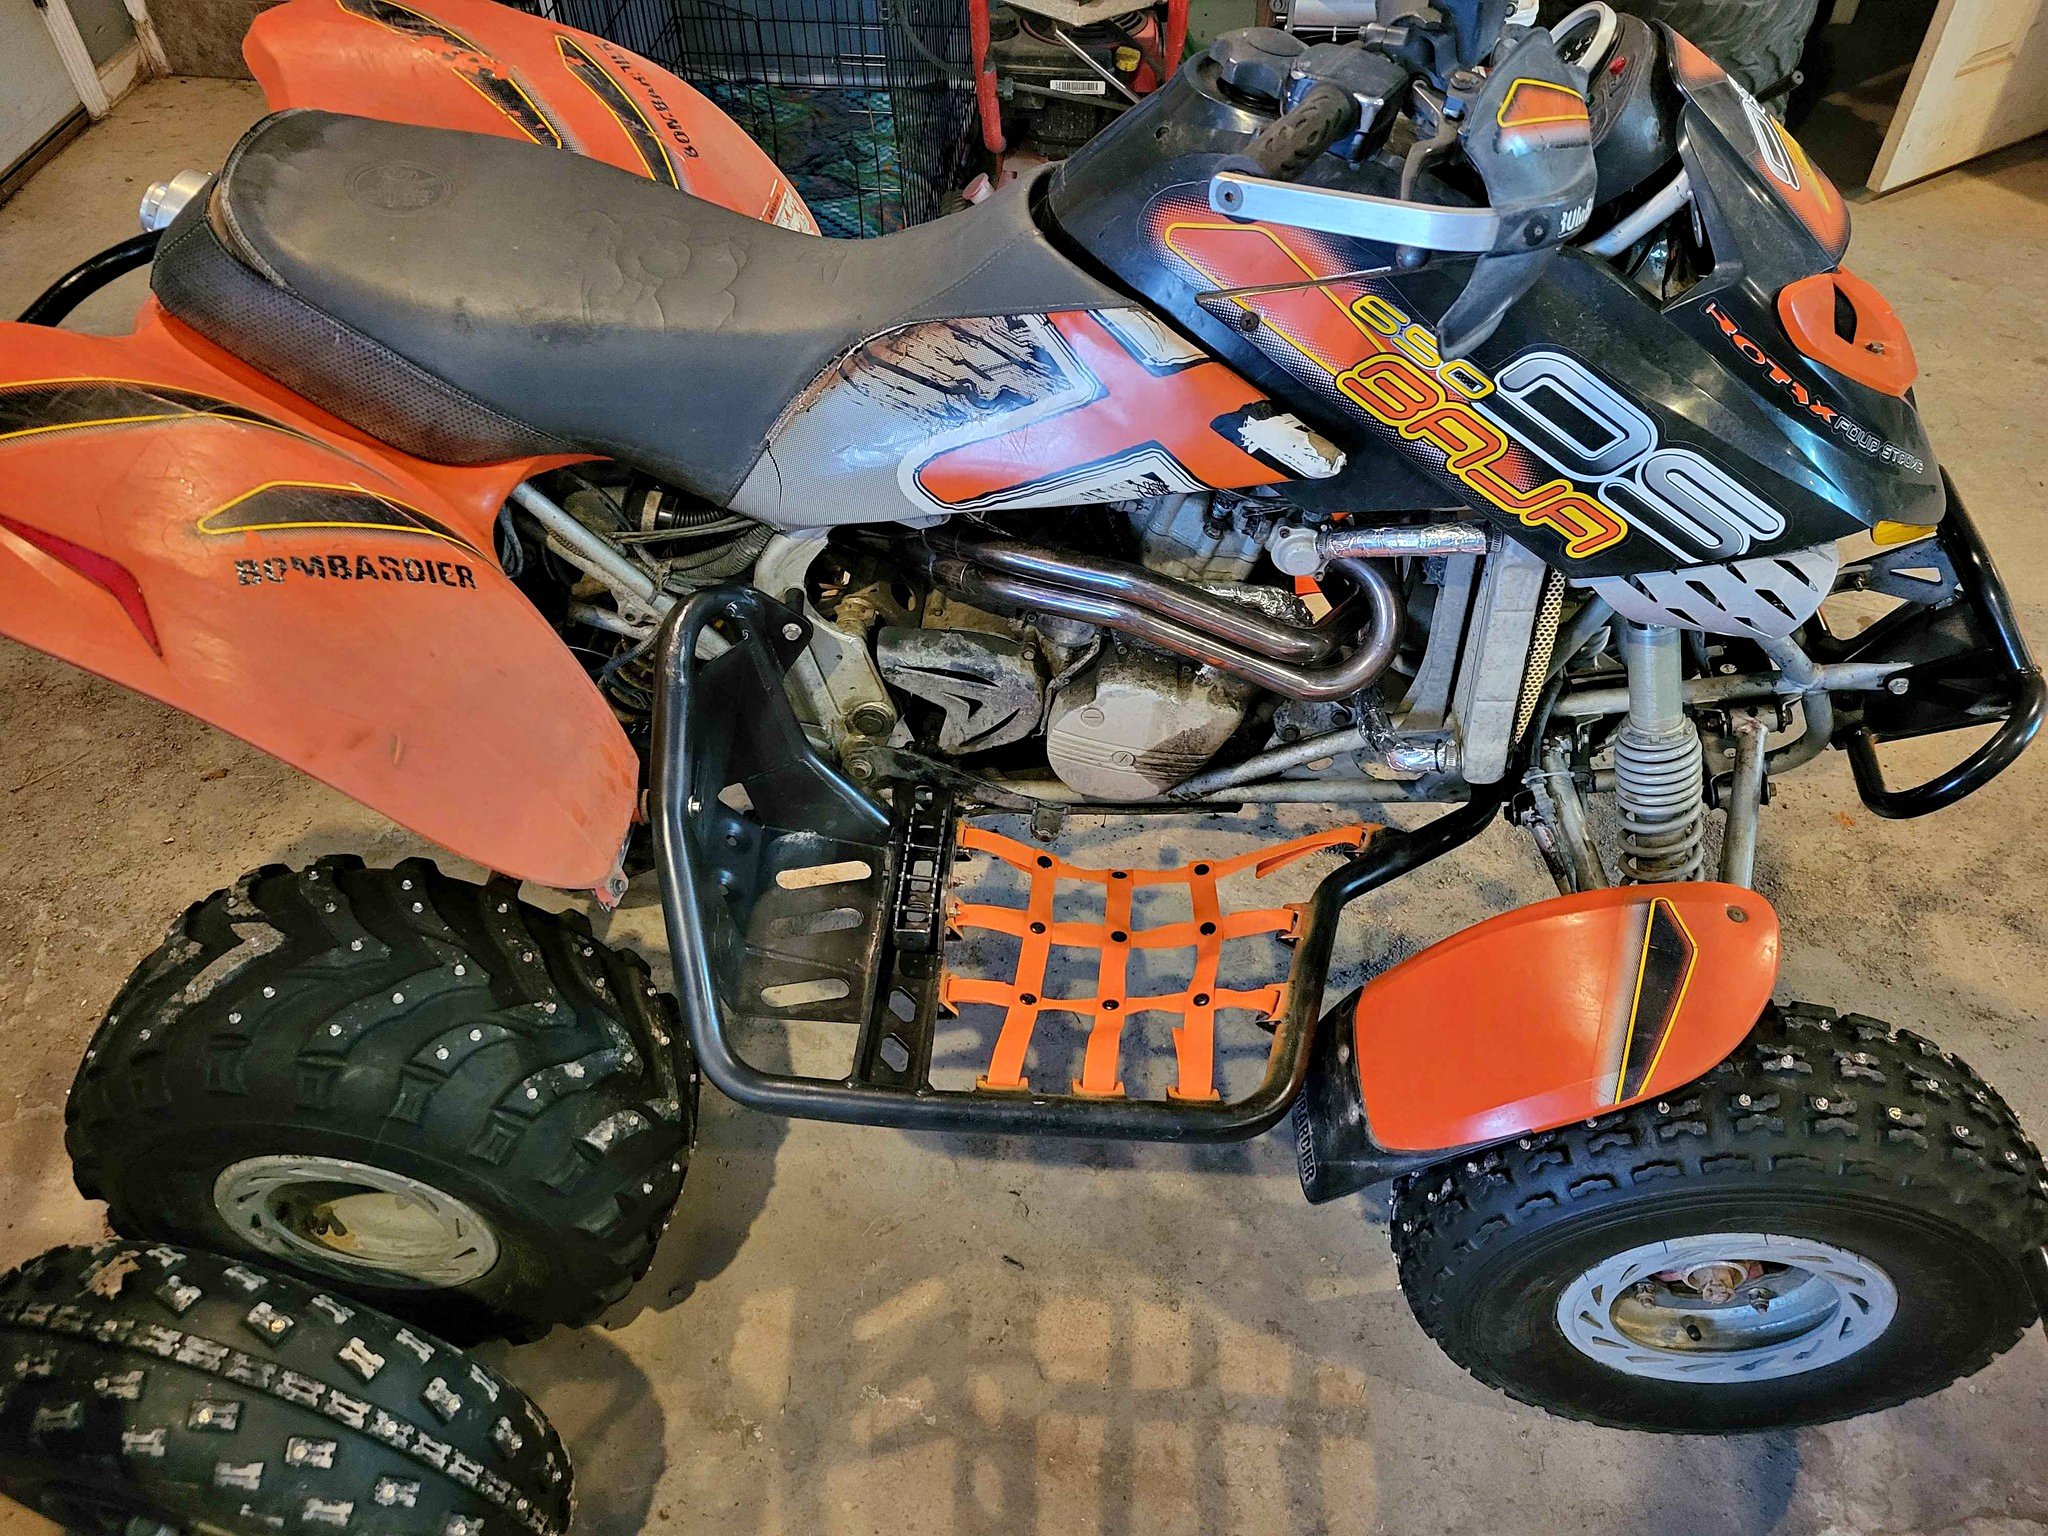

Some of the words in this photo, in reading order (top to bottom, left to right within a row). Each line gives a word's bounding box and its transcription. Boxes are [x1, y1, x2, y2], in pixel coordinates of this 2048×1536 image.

[1351, 294, 1496, 400] 650
[1706, 302, 1838, 423] ROTAX
[1834, 416, 1881, 454] FOUR
[1882, 442, 1925, 474] STROKE
[1335, 352, 1629, 560] BAJA
[1470, 351, 1786, 563] DS
[234, 554, 478, 590] BOMBARDIER
